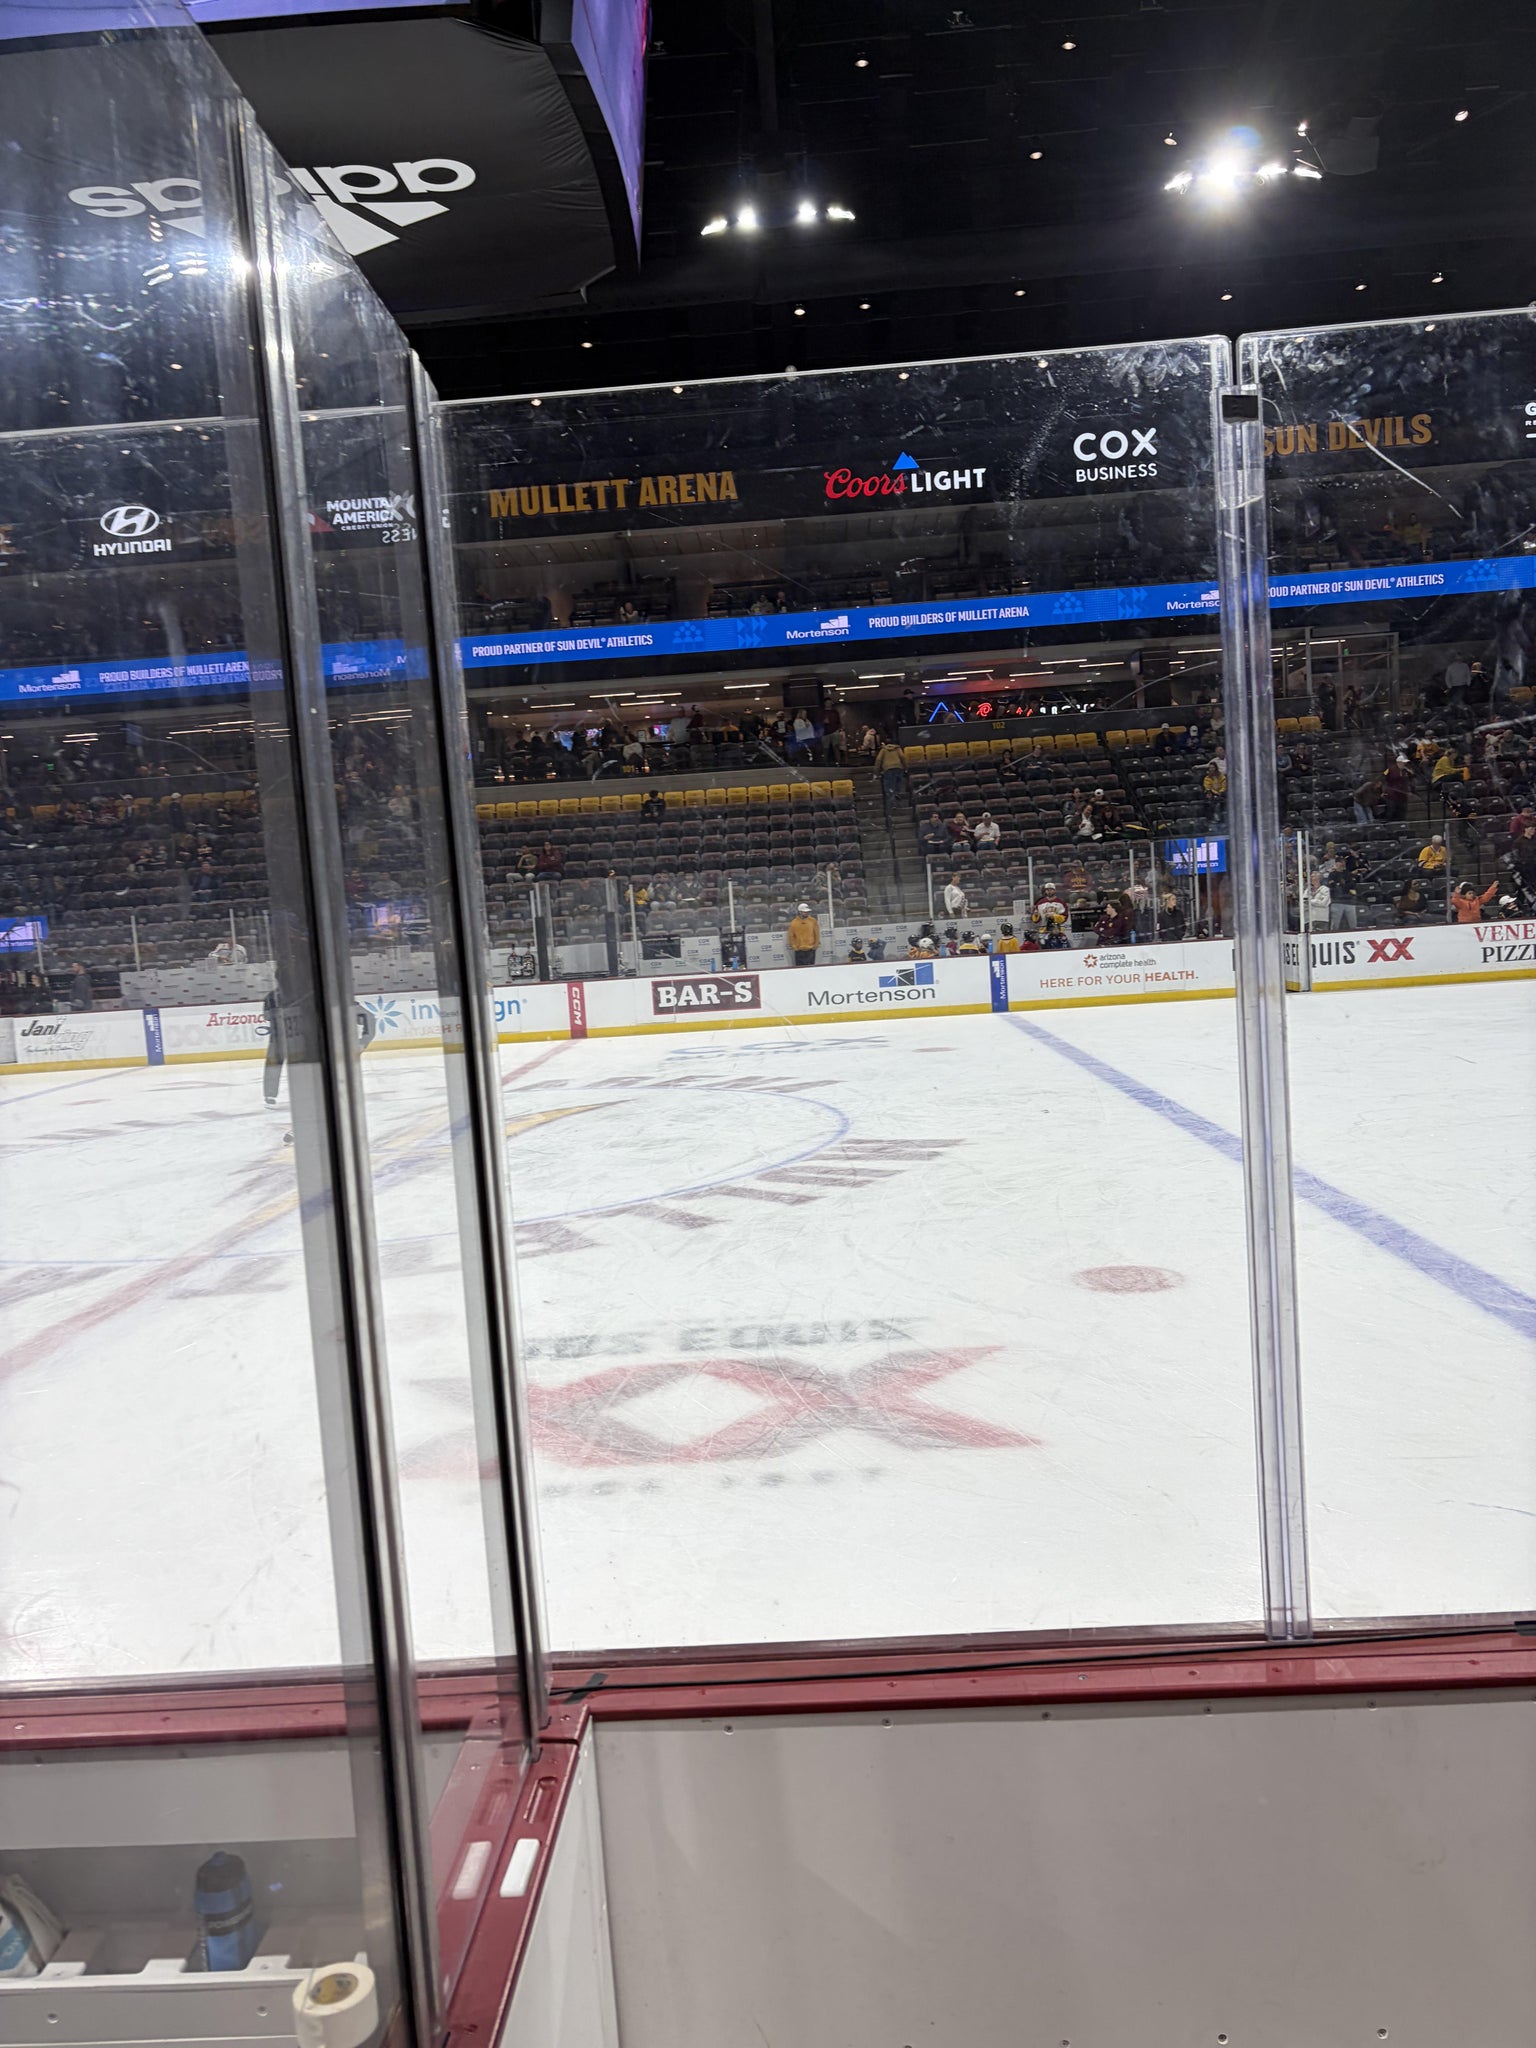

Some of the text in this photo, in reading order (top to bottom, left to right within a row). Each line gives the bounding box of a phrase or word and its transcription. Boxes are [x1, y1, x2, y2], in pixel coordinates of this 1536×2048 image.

[1328, 413, 1433, 451] DEVILS
[1073, 427, 1159, 462] COX
[824, 467, 987, 499] Coors LIGHT
[1075, 463, 1158, 483] BUSINESS
[489, 471, 739, 519] MULLETT ARENA
[93, 537, 173, 557] HYUNDAI
[1290, 583, 1330, 596] PARTNER
[1331, 581, 1343, 593] OF
[1344, 580, 1364, 592] SUN
[1396, 574, 1445, 587] ATHLETICS
[869, 606, 1030, 629] PROUD BUILDERS OF MULLETT ARENA
[786, 628, 849, 640] Mortenson
[472, 645, 503, 657] PROUD
[504, 643, 543, 655] PARTNER
[544, 641, 556, 652] OF
[557, 640, 575, 651] SUN
[607, 634, 653, 648] ATHLETICS
[18, 682, 82, 693] Mortenson
[99, 671, 129, 683] PROUD
[1099, 953, 1126, 961] arizona
[1367, 937, 1415, 963] XX
[1099, 958, 1157, 969] complete health
[1040, 970, 1199, 989] HERE FOR YOUR HEALTH.
[657, 981, 752, 1008] BAR-S
[808, 987, 936, 1006] Mortenson
[571, 986, 582, 1026] CCM
[21, 1020, 62, 1037] Jani
